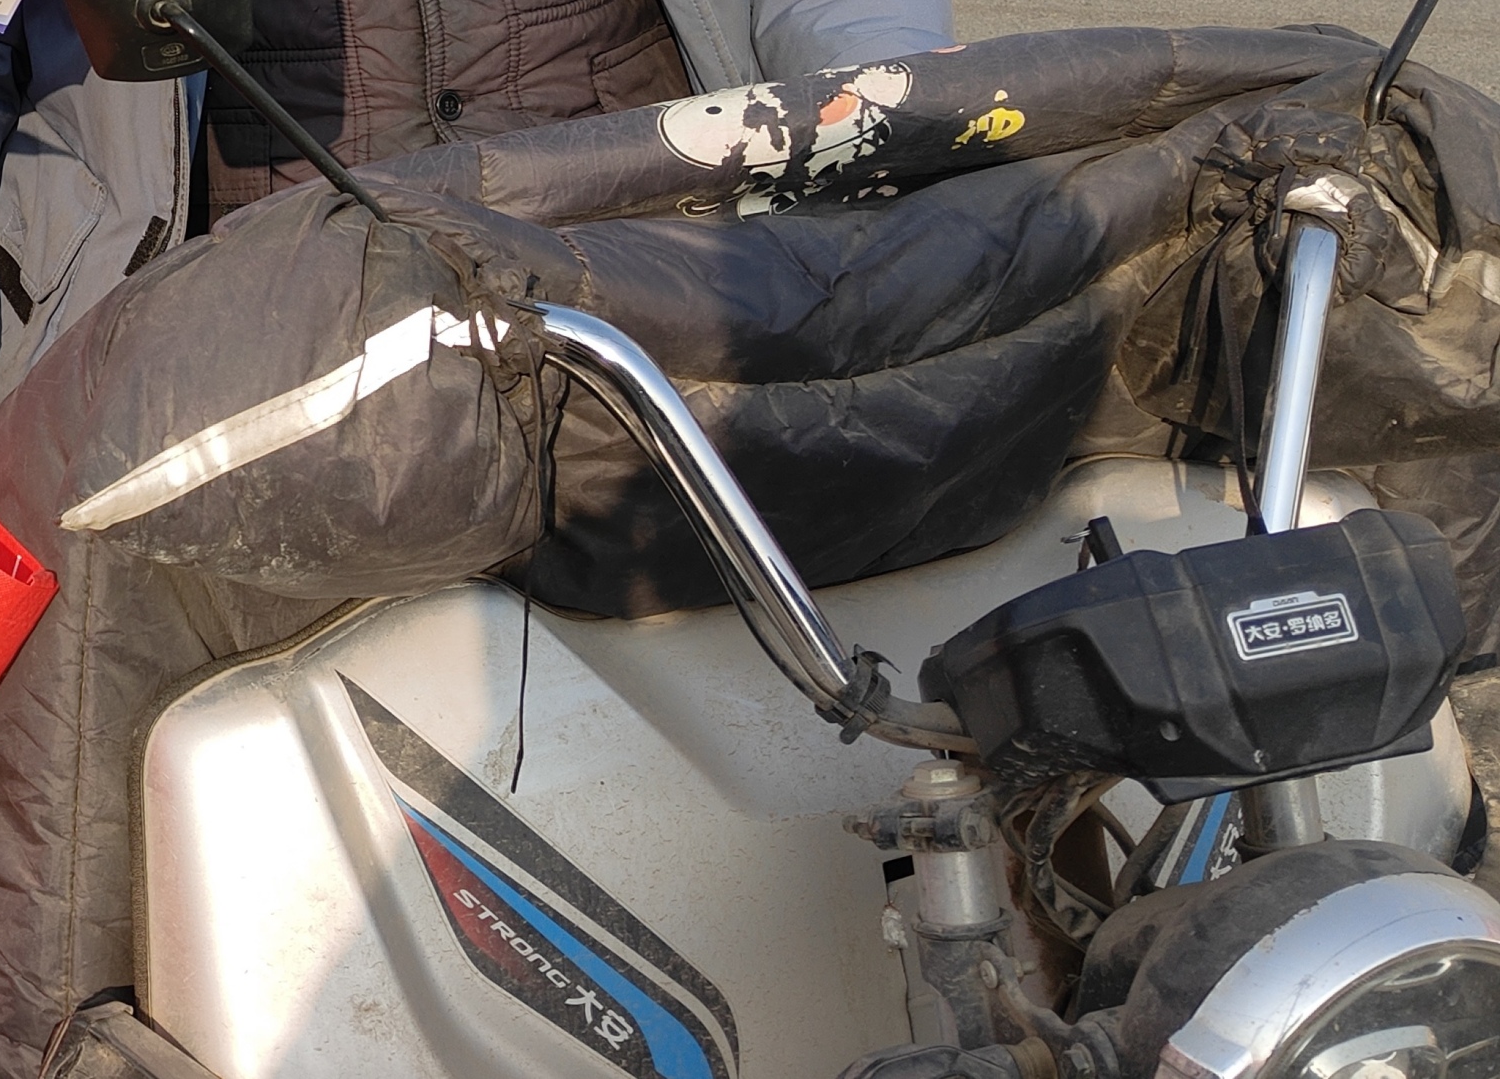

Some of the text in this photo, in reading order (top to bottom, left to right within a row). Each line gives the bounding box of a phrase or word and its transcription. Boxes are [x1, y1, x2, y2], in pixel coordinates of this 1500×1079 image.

[1244, 610, 1343, 644] 大安·罗纳多
[453, 889, 571, 989] STRONG
[564, 984, 634, 1051] 大安
